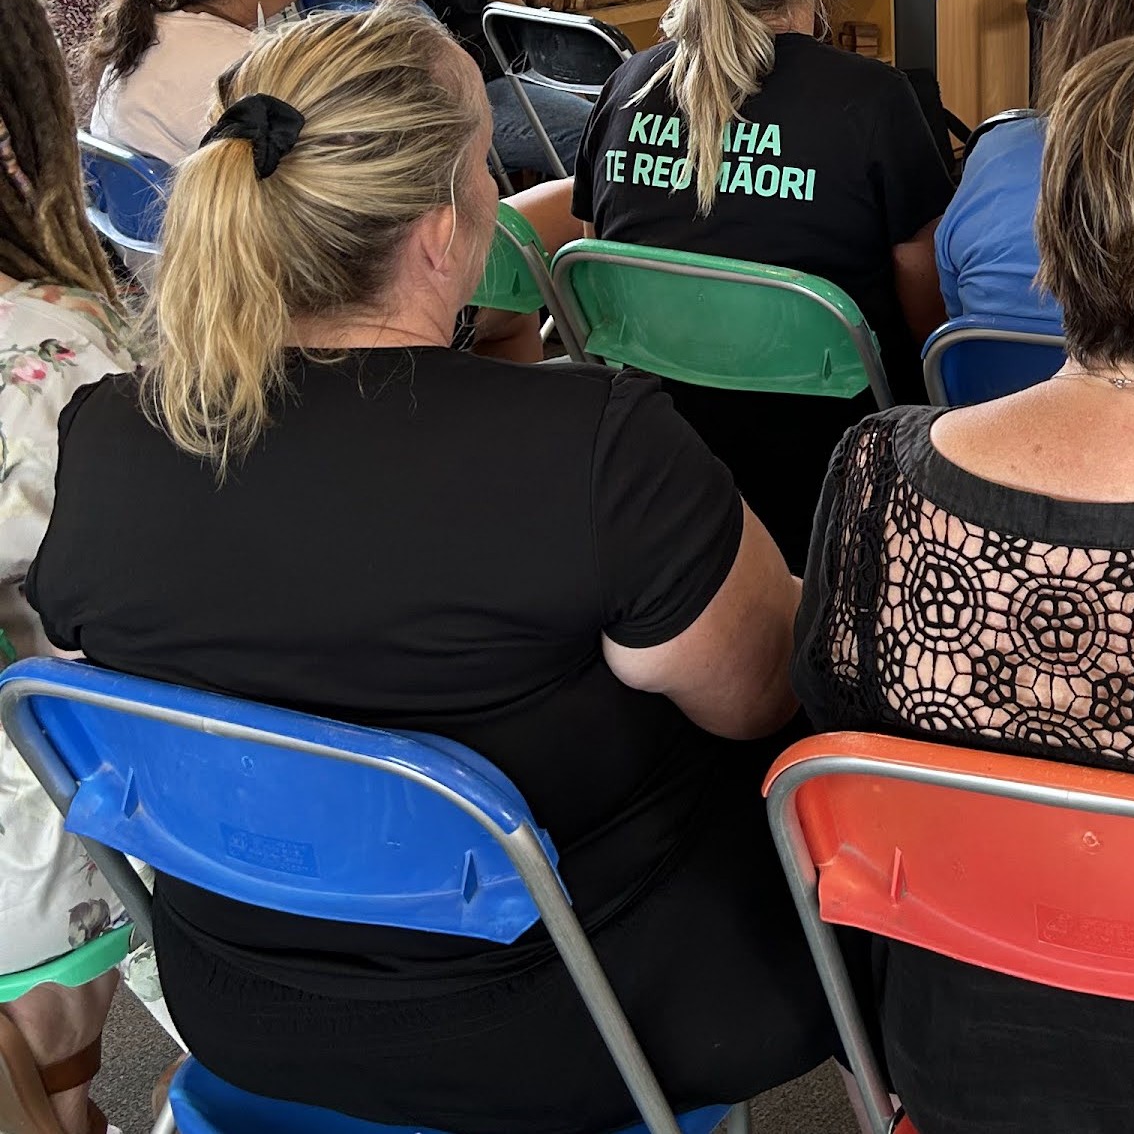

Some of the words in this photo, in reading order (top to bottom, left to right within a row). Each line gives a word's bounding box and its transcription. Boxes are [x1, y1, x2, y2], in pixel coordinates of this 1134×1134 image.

[628, 112, 680, 148] KIA
[605, 150, 628, 183] TE
[632, 153, 692, 190] REO
